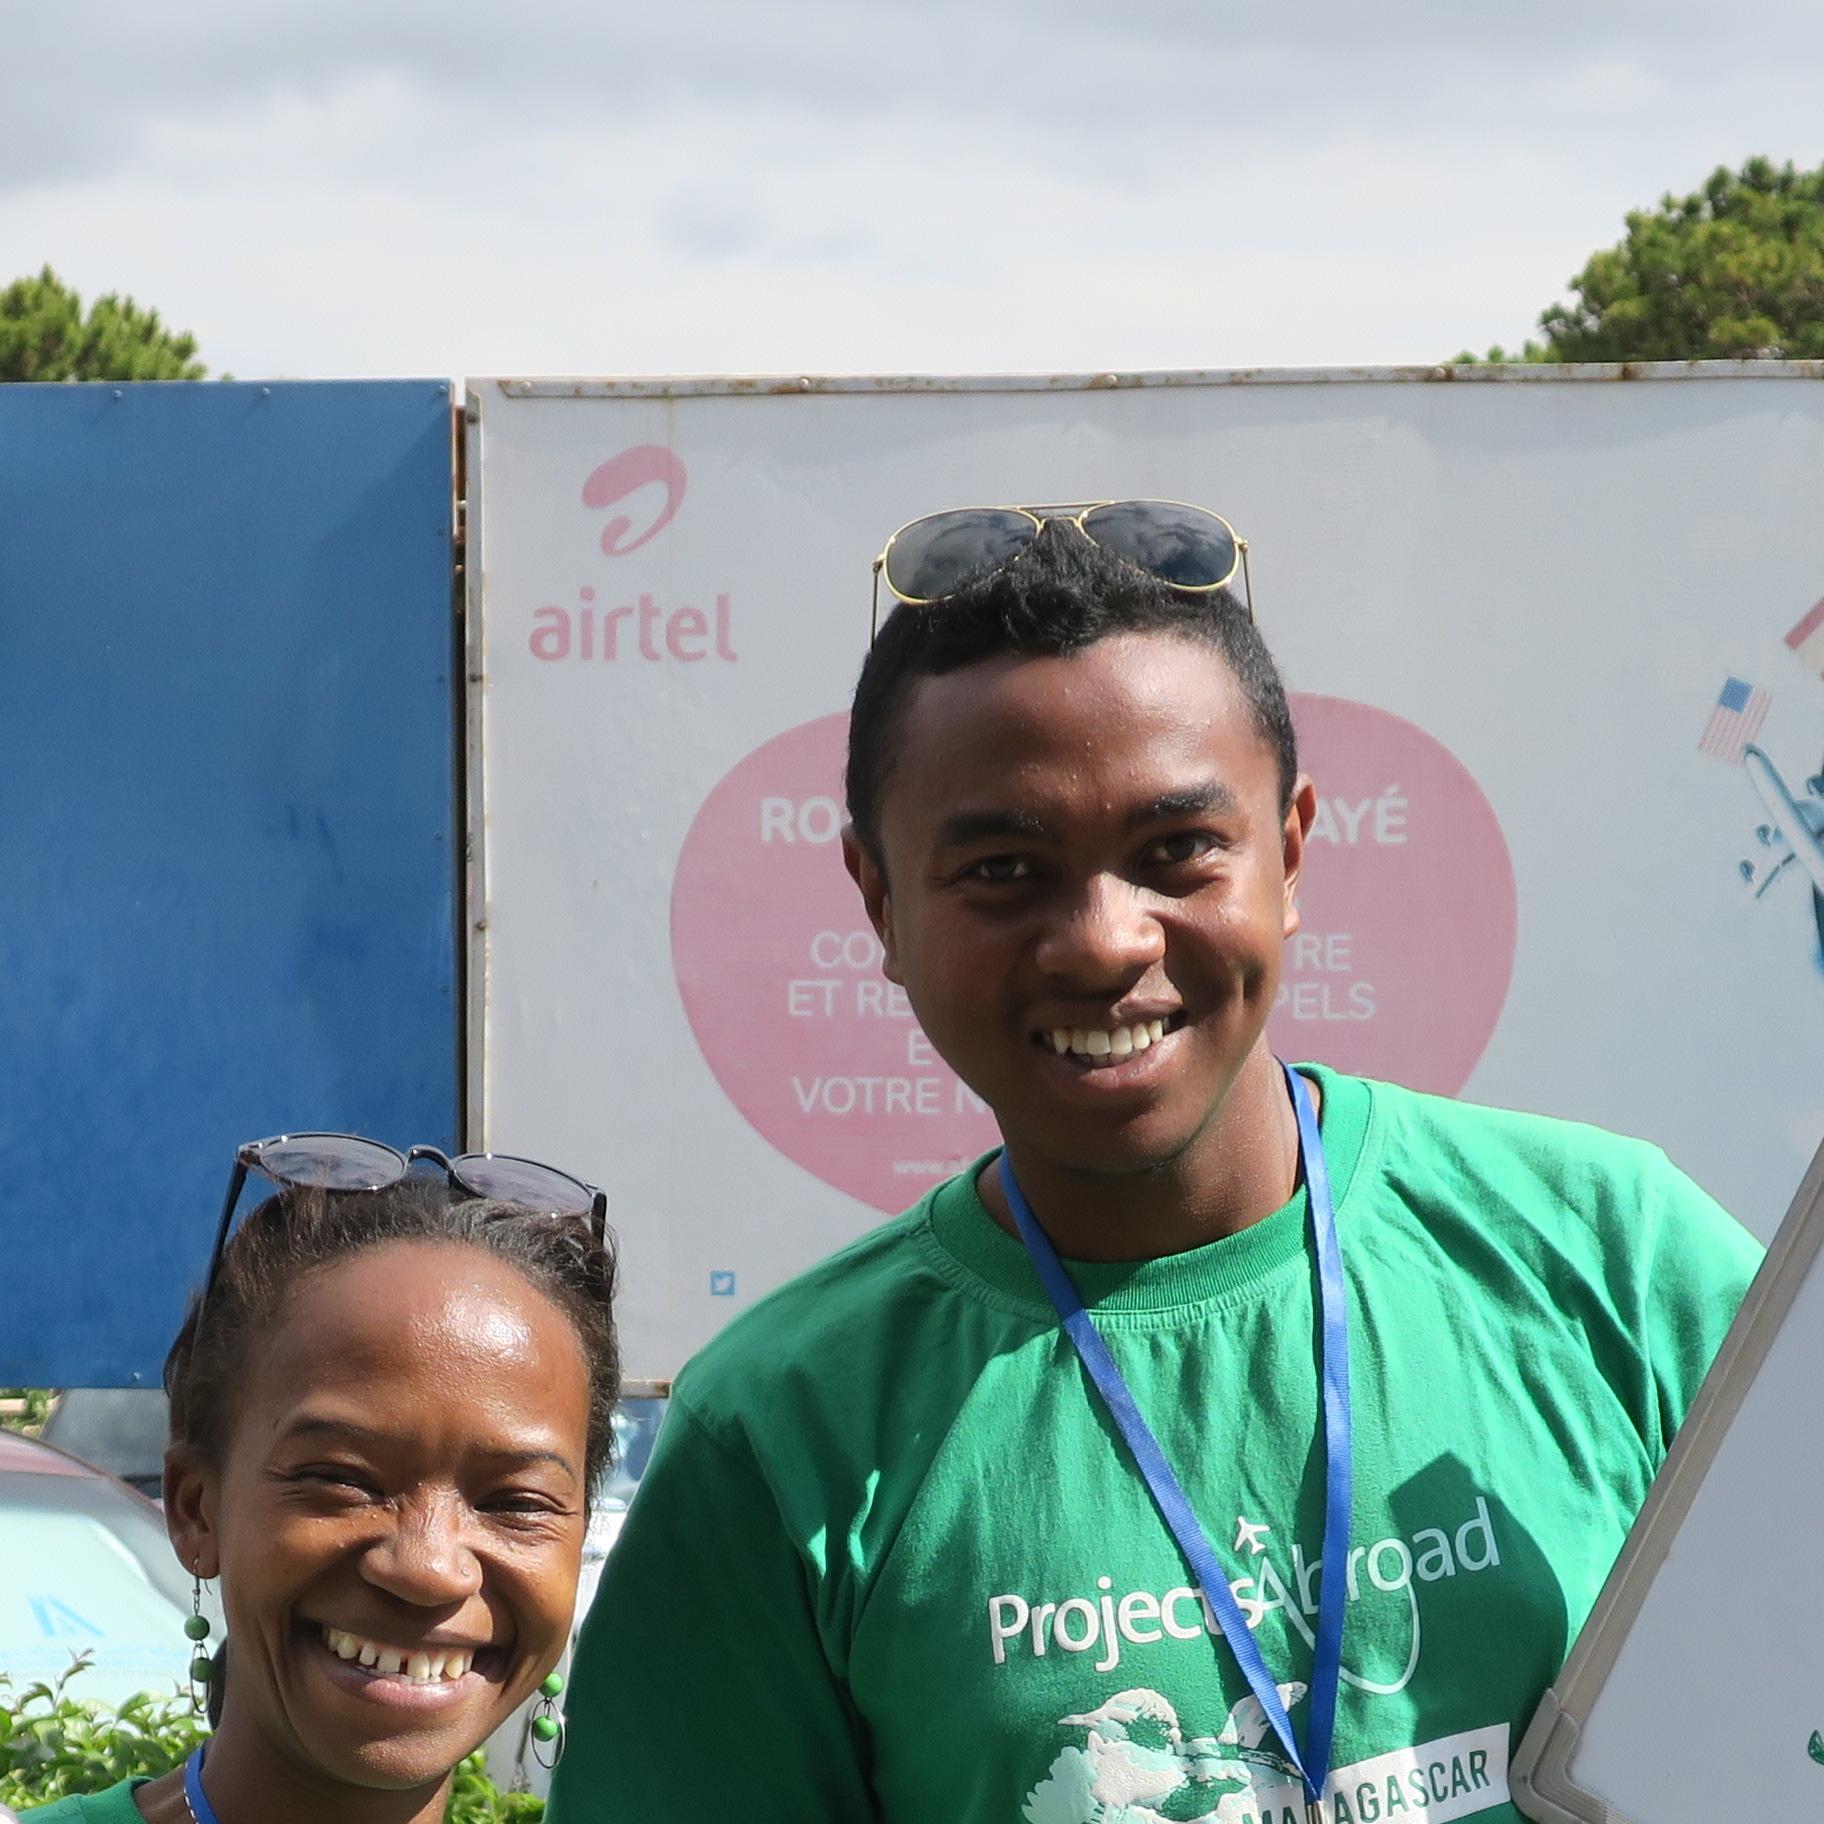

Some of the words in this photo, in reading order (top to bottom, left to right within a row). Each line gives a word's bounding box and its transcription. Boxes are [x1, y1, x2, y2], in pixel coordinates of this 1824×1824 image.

[528, 586, 738, 663] airtel
[788, 979, 843, 1016] ET
[792, 1076, 943, 1116] VOTRE
